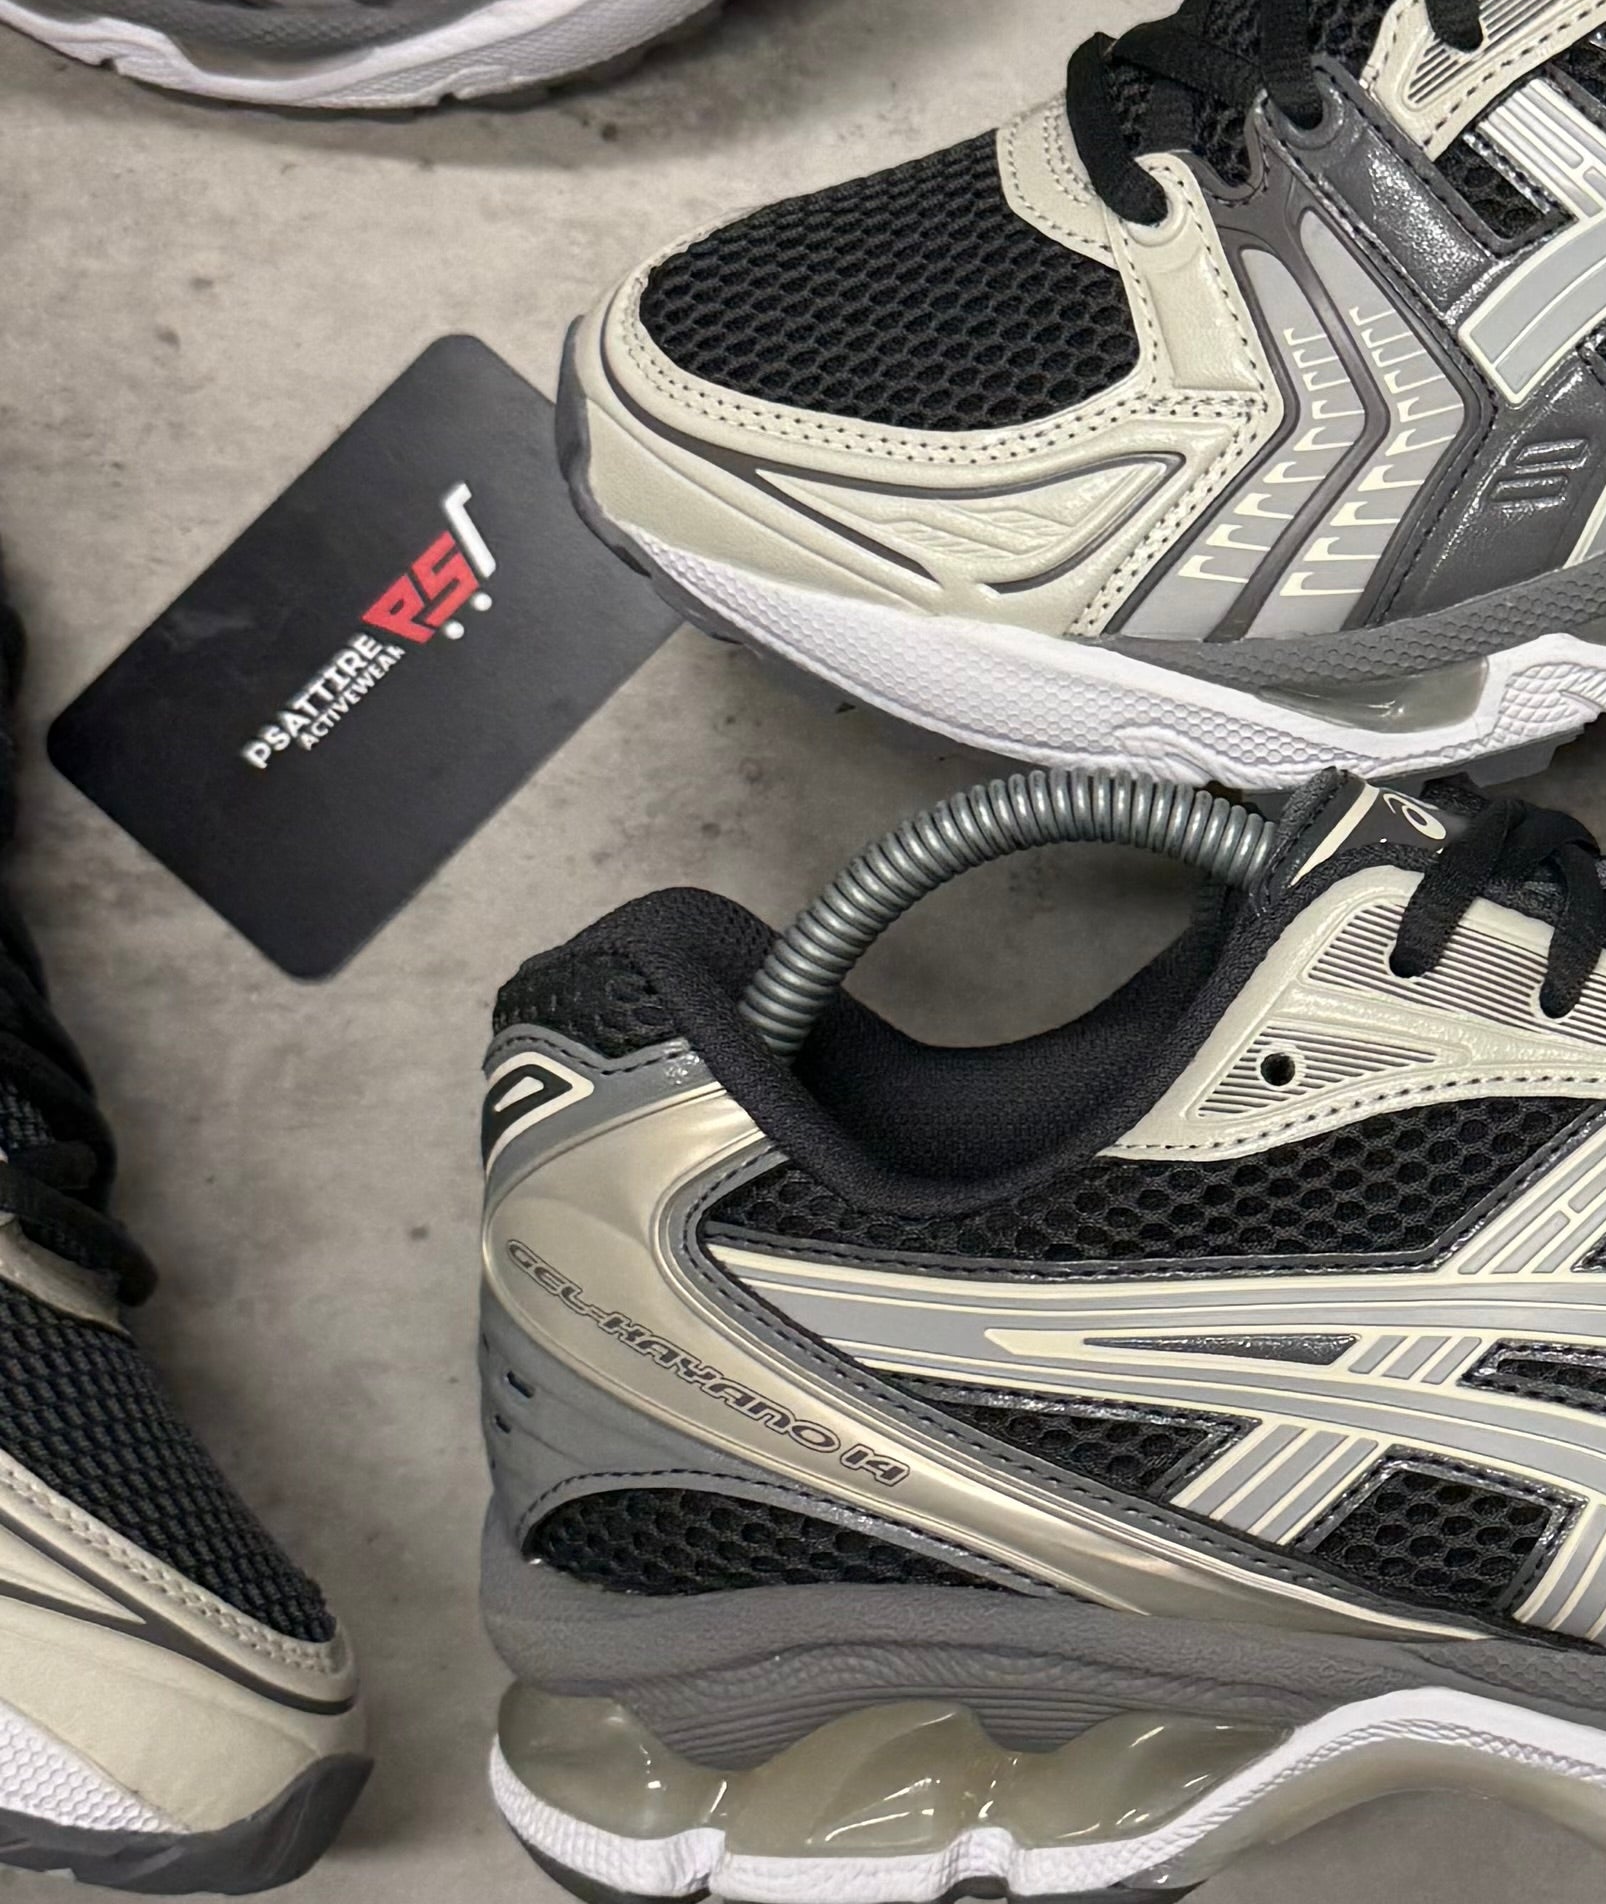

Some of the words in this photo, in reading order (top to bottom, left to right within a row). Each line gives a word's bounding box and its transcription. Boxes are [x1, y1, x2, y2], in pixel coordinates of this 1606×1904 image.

[241, 633, 383, 769] PSATTIRE
[298, 645, 406, 751] ACTIVEWEAR
[840, 1443, 910, 1487] 14
